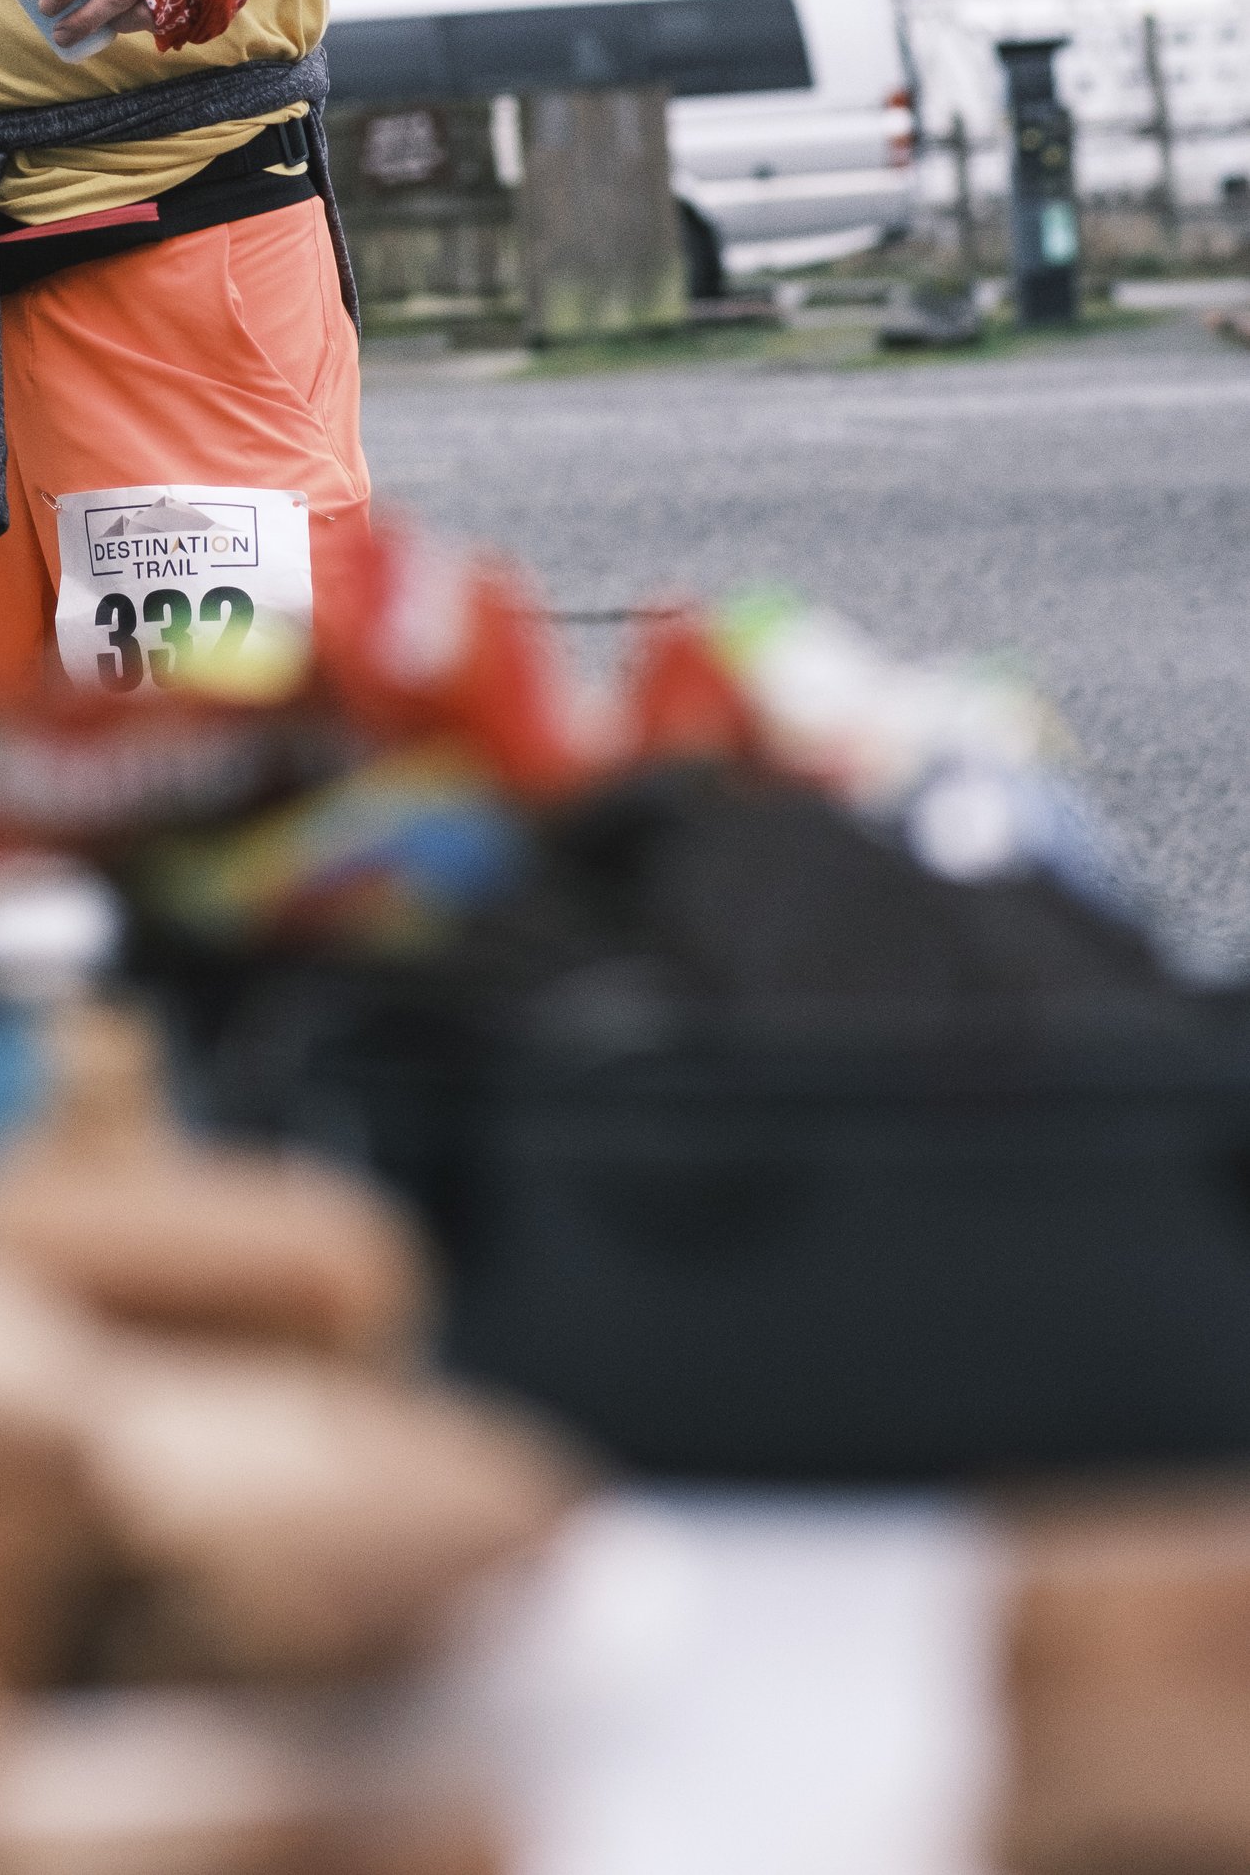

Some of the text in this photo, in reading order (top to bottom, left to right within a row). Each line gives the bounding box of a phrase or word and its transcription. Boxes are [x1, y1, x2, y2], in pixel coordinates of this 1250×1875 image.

[93, 535, 250, 562] DESTINATION
[132, 558, 199, 580] TRAIL
[94, 585, 256, 695] 332
